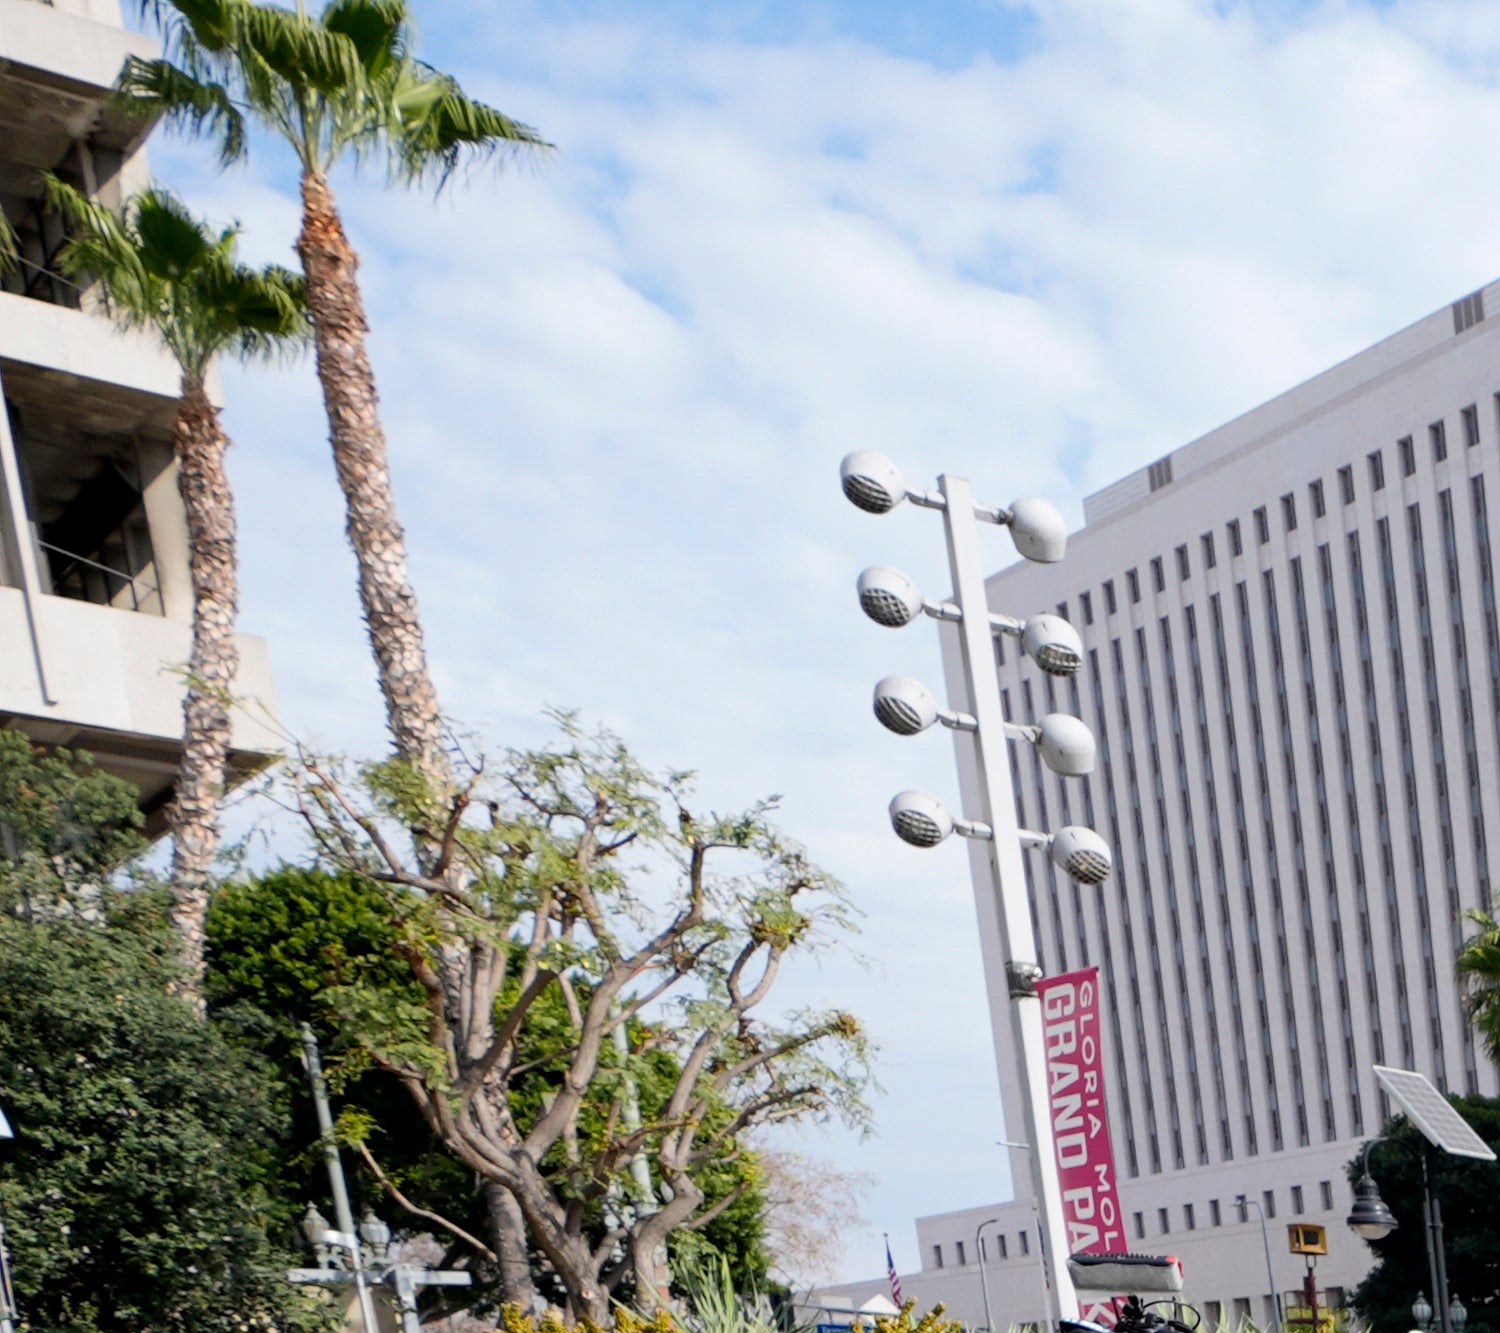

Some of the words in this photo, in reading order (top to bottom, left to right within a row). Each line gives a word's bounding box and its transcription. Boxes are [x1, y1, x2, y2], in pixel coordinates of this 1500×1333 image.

[1044, 983, 1088, 1169] GRAND
[1078, 980, 1102, 1139] GLORIA
[1093, 1163, 1118, 1251] MOL
[1063, 1186, 1113, 1330] PAK
